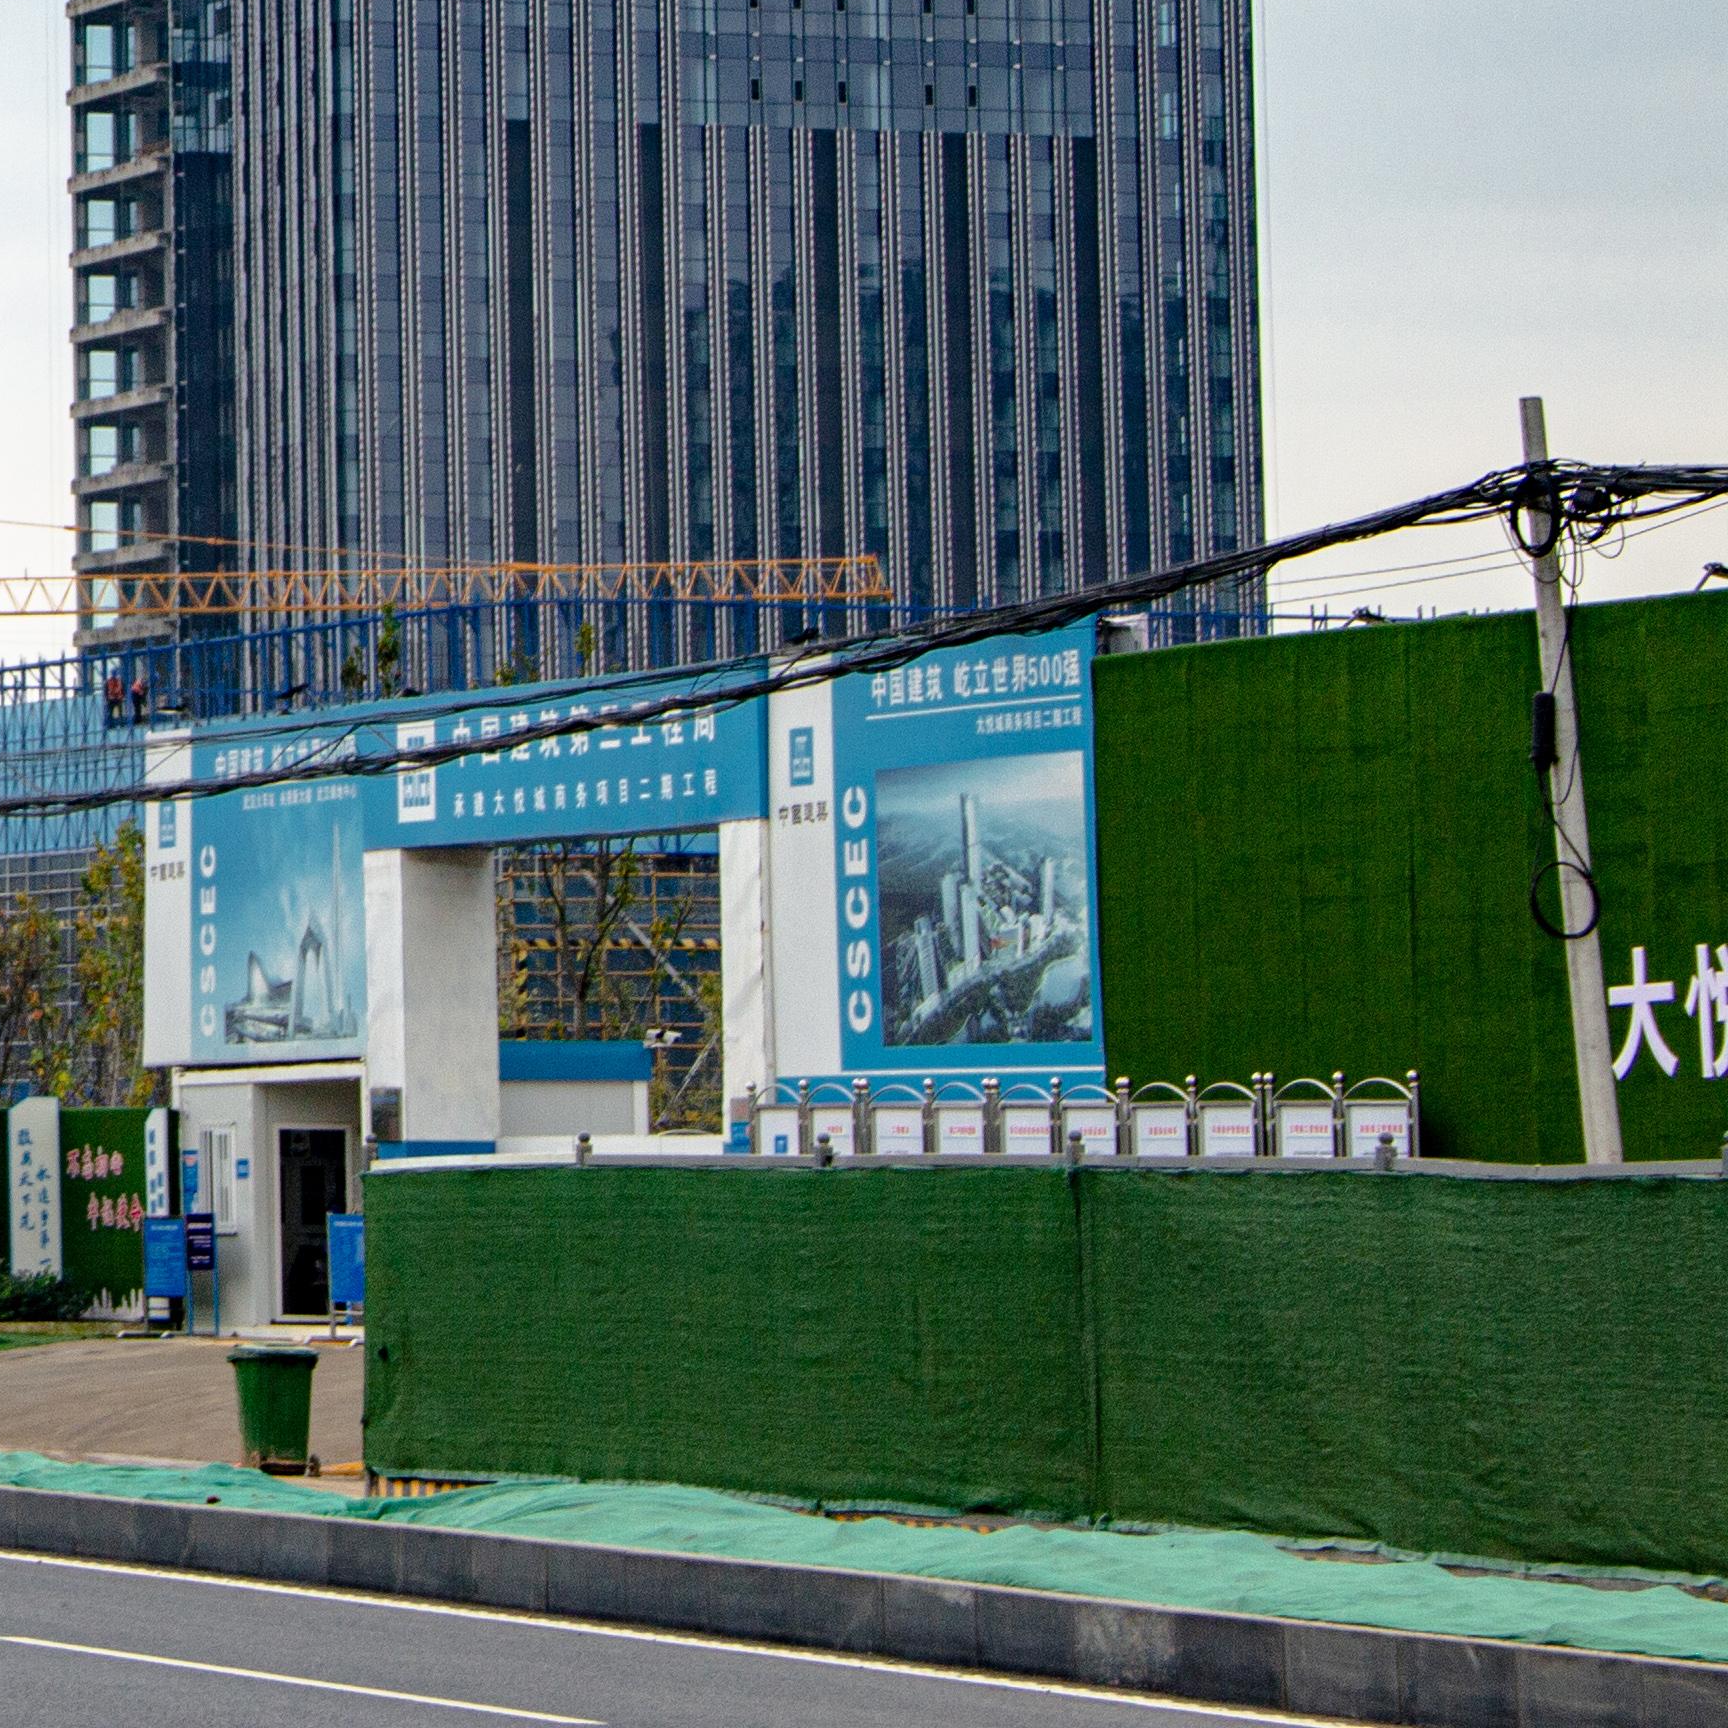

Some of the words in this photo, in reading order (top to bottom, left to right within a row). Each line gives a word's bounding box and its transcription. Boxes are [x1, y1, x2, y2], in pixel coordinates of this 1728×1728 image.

[871, 663, 943, 707] 中国建筑
[953, 649, 1081, 697] 屹立世界500强
[453, 768, 717, 818] 承建大悦城商务项目二期工程
[199, 844, 217, 1038] CSCEC
[842, 785, 873, 1034] CSCEC
